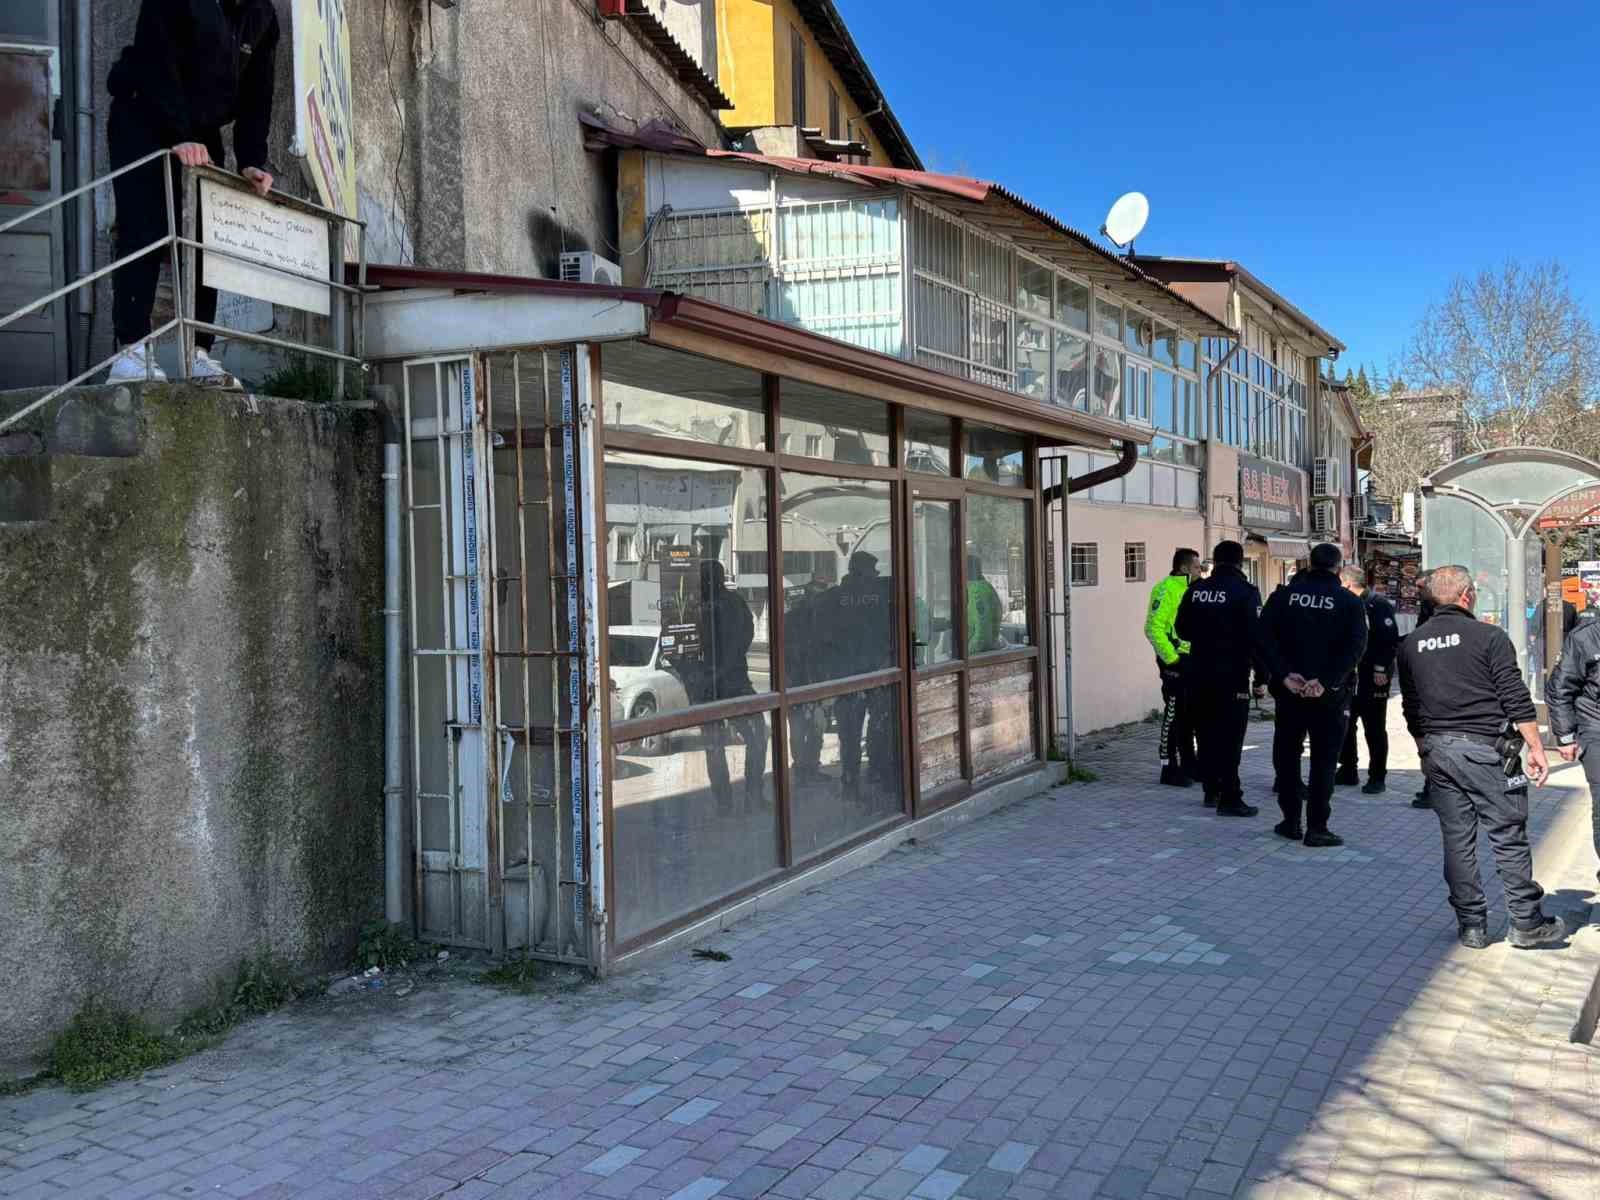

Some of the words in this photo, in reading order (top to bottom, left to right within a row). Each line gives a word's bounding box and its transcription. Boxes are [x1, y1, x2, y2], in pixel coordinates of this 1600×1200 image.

[565, 454, 574, 492] EUROPEN
[466, 474, 474, 511] EUROPEN
[568, 508, 576, 545] EUROPEN
[468, 527, 476, 564] EUROPEN
[470, 579, 478, 616] EUROPEN
[1192, 590, 1227, 603] POLiS
[1289, 593, 1335, 610] POLiS
[570, 615, 578, 652] EUROPEN
[1417, 633, 1461, 653] POLiS
[571, 670, 579, 707] EUROPEN
[574, 777, 582, 815] EUROPEN
[575, 830, 583, 868] EUROPEN
